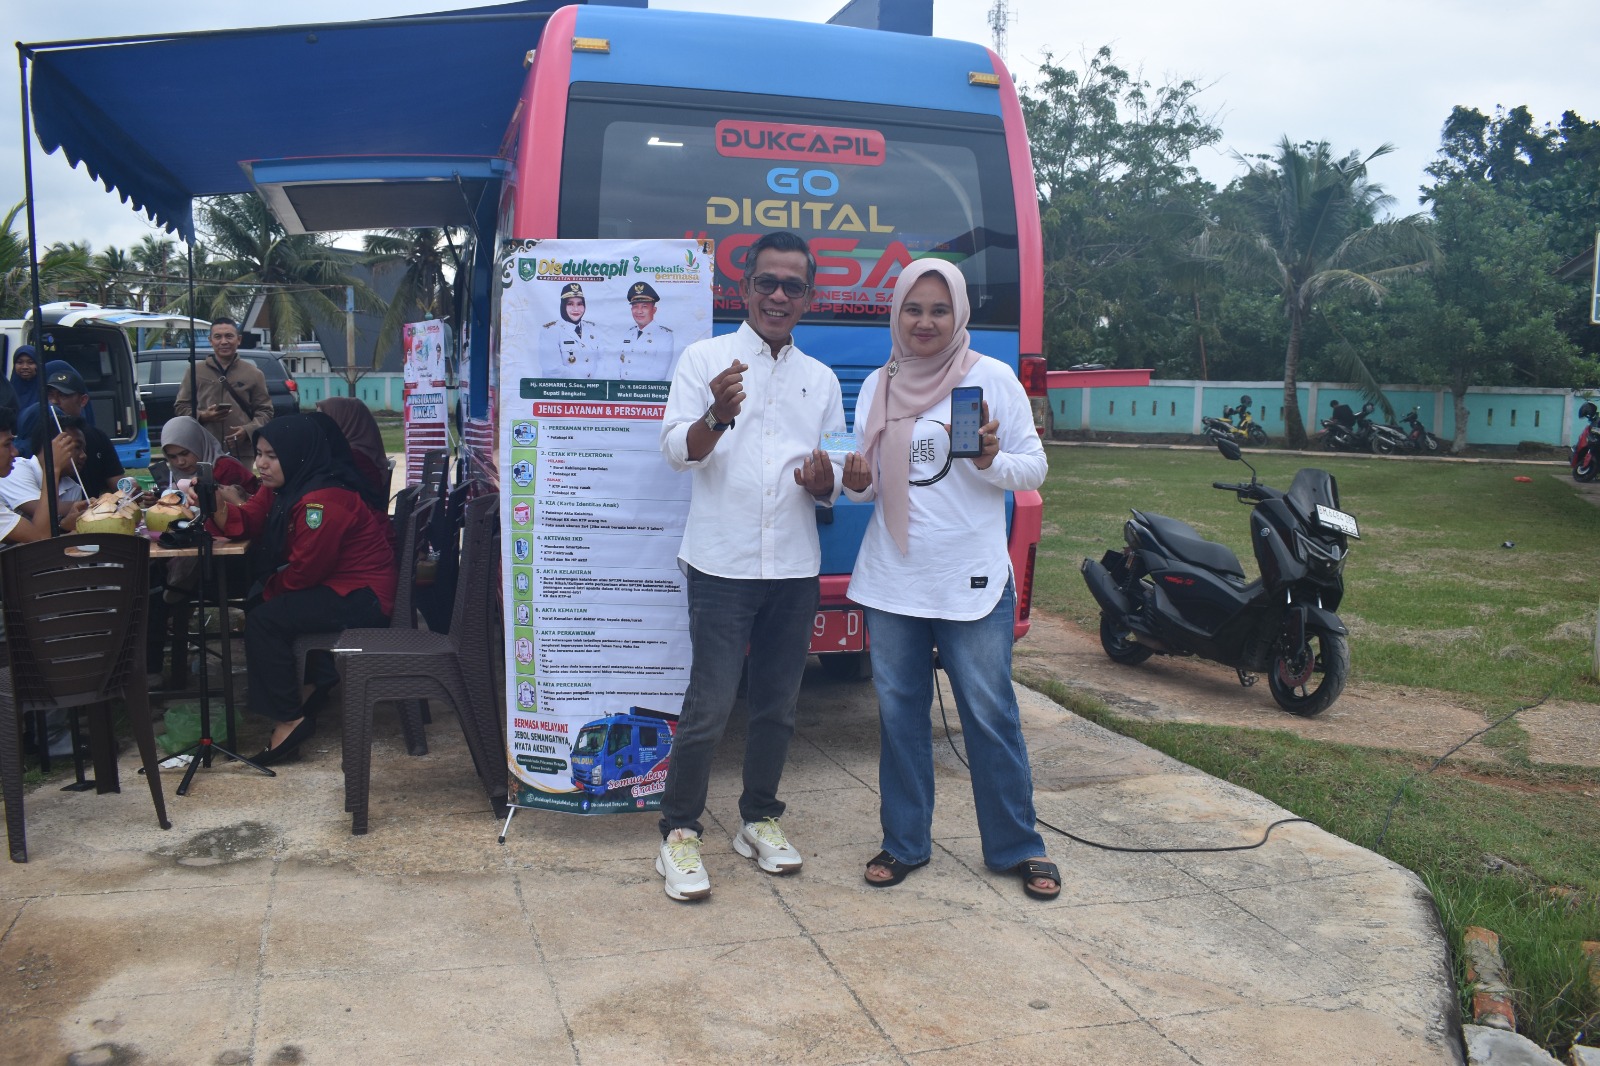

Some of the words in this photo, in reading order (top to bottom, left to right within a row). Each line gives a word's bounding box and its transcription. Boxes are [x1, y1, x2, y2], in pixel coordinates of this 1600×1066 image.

[721, 128, 879, 156] DUKCAPIL
[767, 167, 839, 196] GO
[706, 196, 895, 233] DIGITAL
[715, 232, 914, 288] GSA
[538, 258, 629, 279] Disdukcapil
[538, 405, 562, 414] JENIS
[564, 406, 603, 414] LAYANAN
[606, 407, 612, 415] &
[615, 407, 665, 416] PERSYARAT
[910, 439, 934, 451] UEE
[848, 612, 859, 636] D
[514, 718, 539, 730] BERMASA
[541, 721, 568, 733] MELAYANI
[515, 731, 530, 740] JEBOL
[515, 742, 531, 751] NYATA
[533, 745, 556, 754] AKSINYA
[607, 775, 644, 790] Semua
[631, 781, 666, 797] Gratis
